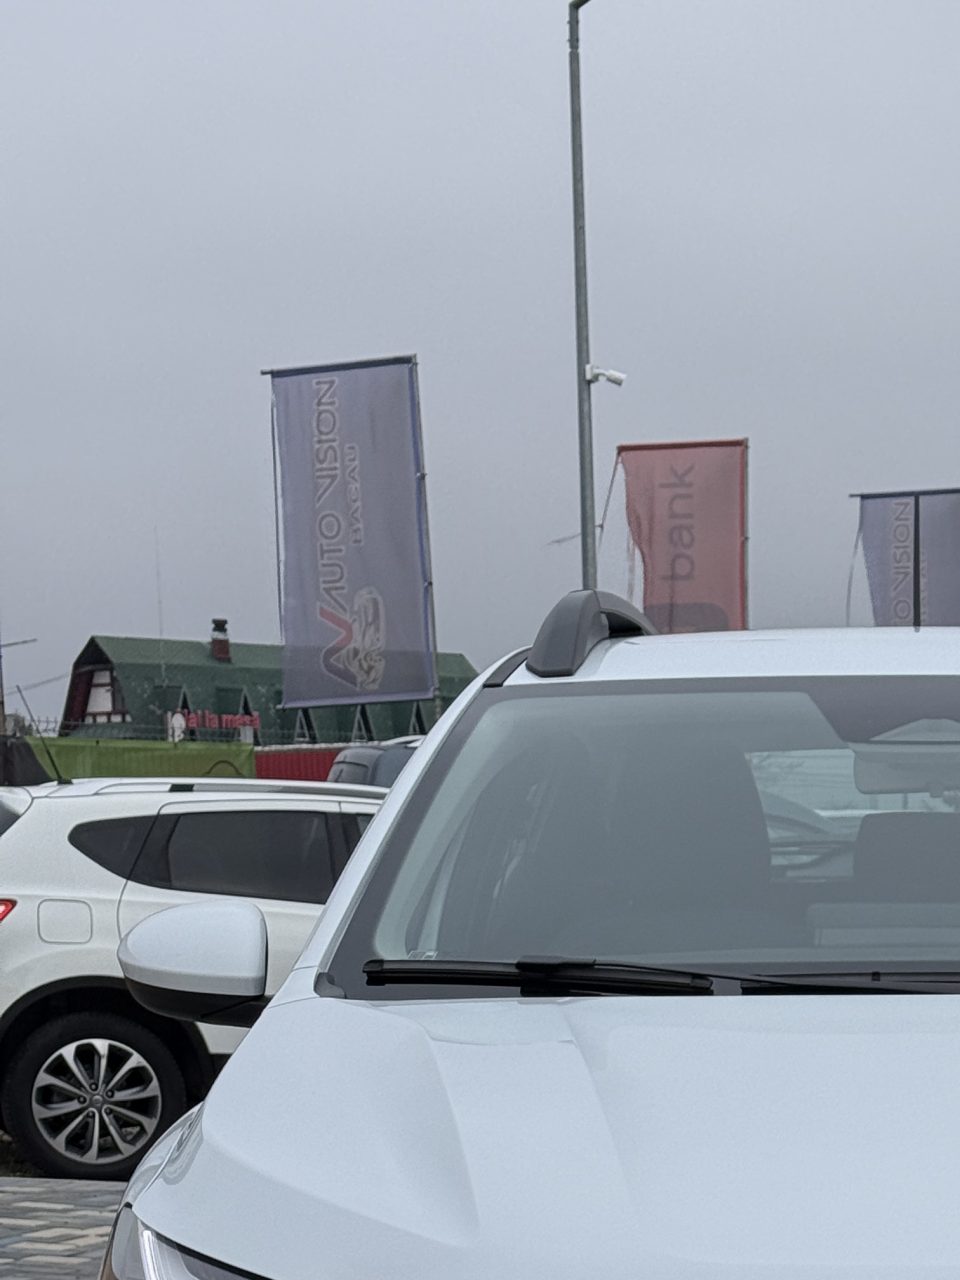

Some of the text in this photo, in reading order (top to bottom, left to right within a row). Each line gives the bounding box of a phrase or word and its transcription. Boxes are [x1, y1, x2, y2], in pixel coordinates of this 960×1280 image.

[313, 377, 347, 611] AUTO VISION
[345, 443, 363, 546] BACAU
[658, 462, 696, 582] bank
[892, 500, 912, 593] VISION
